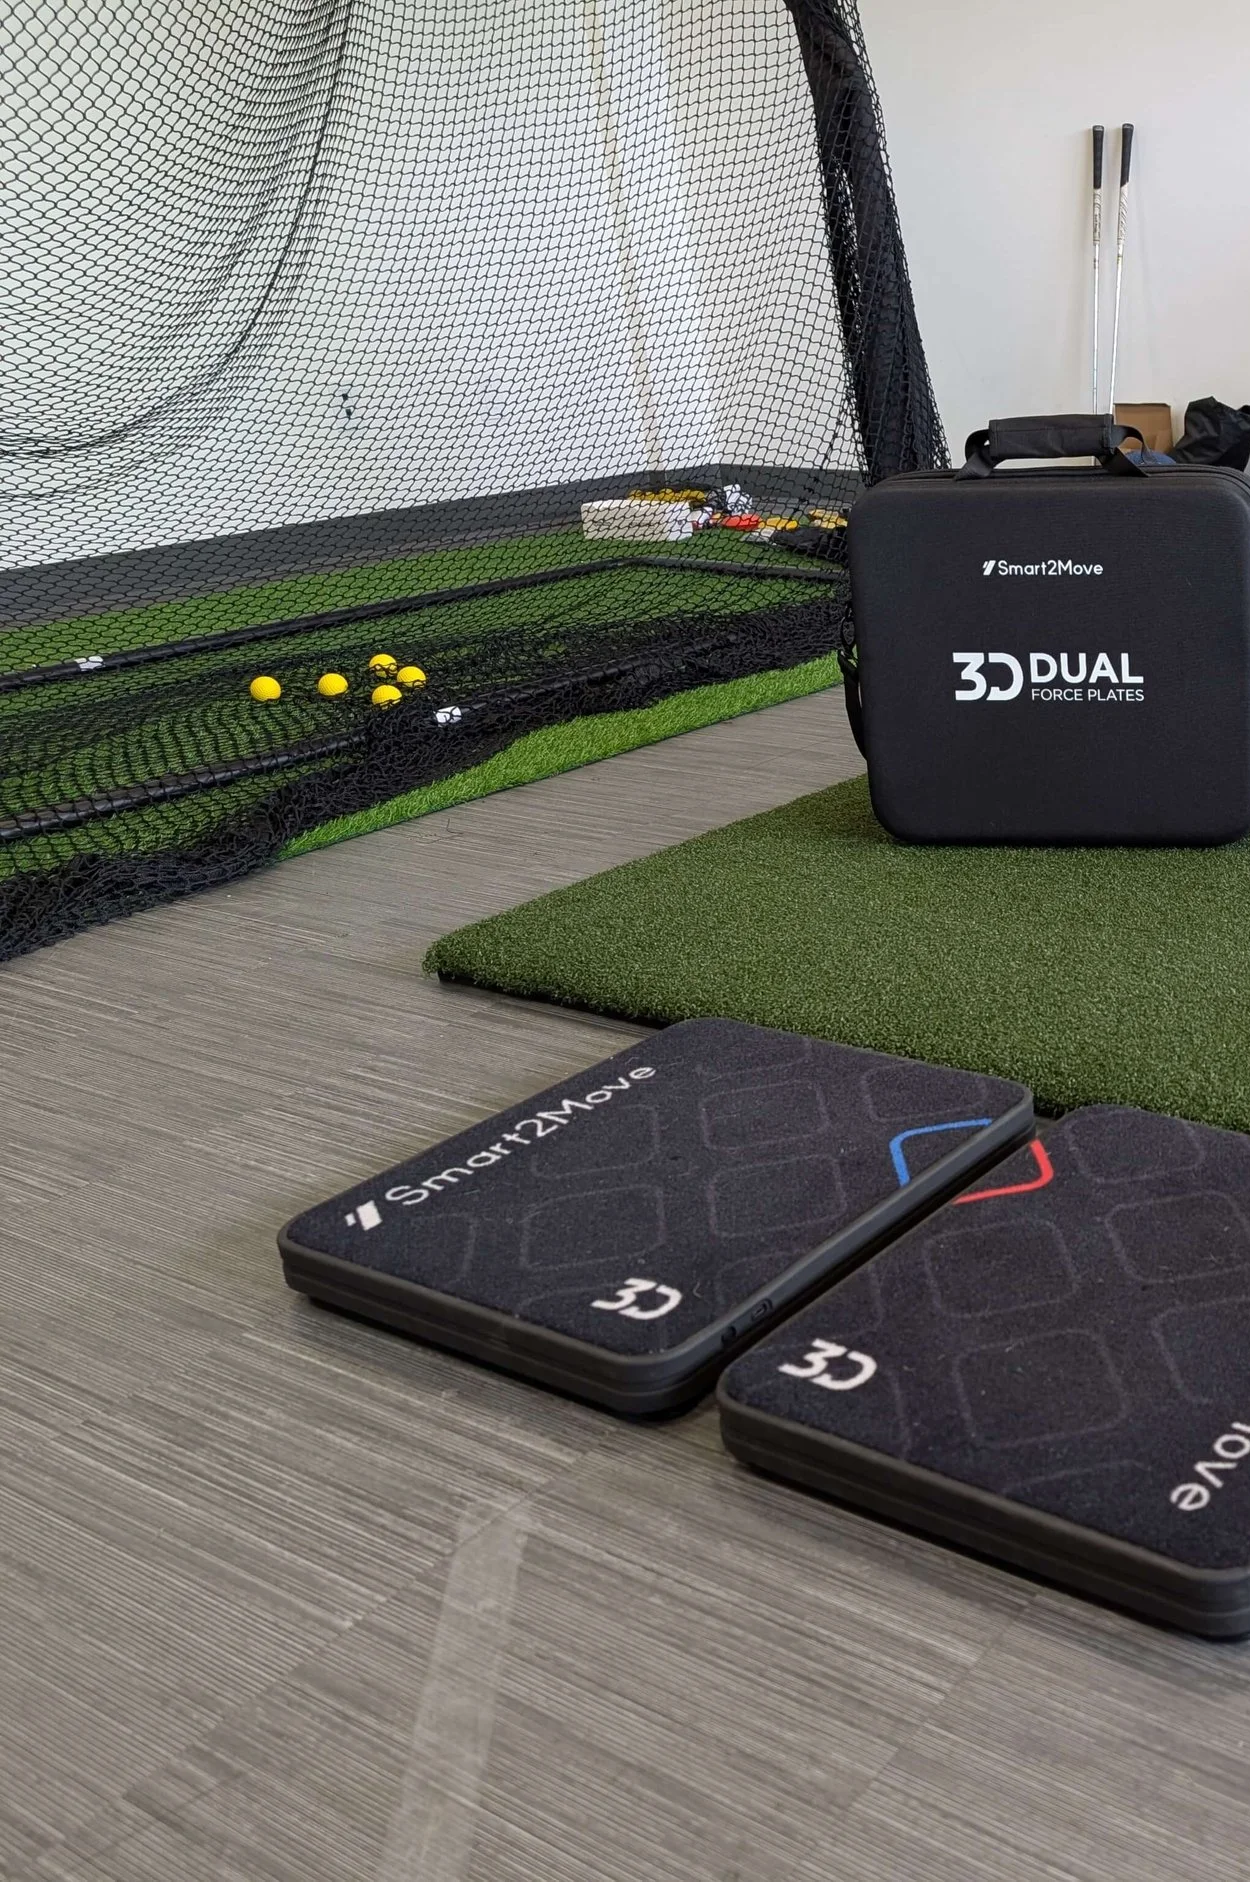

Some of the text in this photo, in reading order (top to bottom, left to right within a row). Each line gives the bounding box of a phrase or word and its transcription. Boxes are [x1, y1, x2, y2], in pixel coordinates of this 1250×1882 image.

[997, 559, 1104, 576] Smart2Move
[952, 652, 1024, 701] 3D
[1030, 652, 1145, 684] DUAL
[1031, 688, 1145, 702] FORCE PLATES
[384, 1066, 656, 1206] Smart2Move
